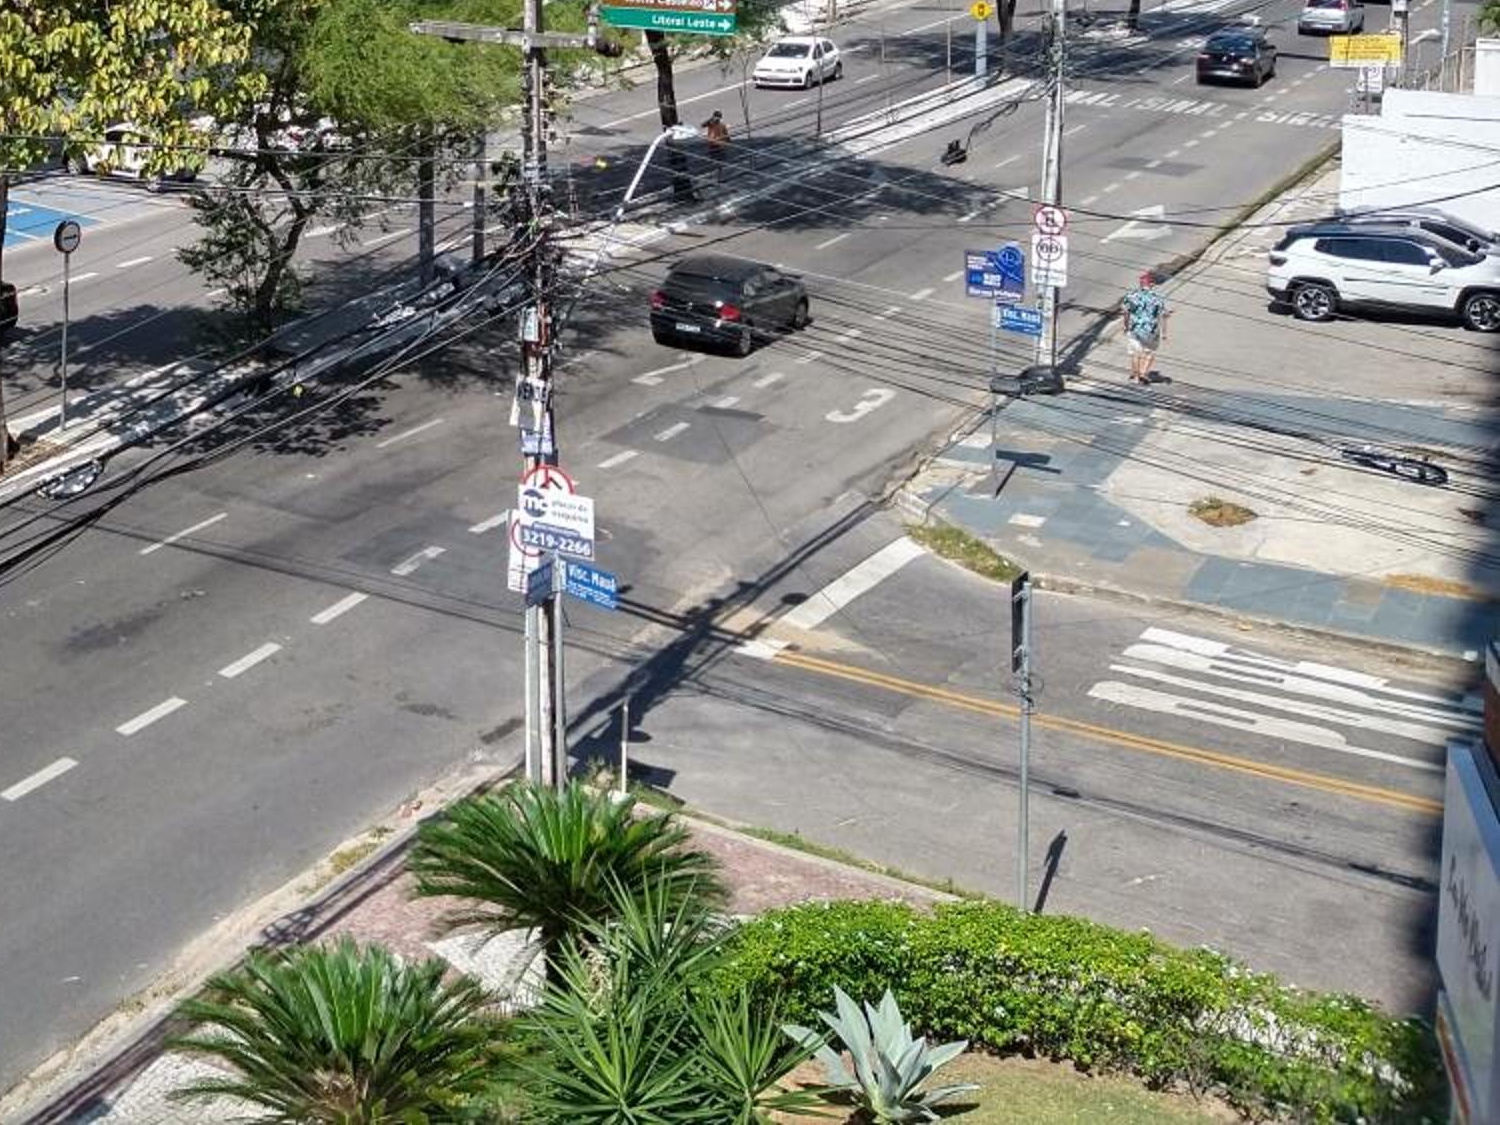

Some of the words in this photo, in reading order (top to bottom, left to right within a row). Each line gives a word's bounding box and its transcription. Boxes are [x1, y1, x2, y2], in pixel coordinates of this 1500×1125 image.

[652, 15, 685, 26] Litoral
[687, 17, 716, 29] Leste
[825, 388, 897, 423] 3
